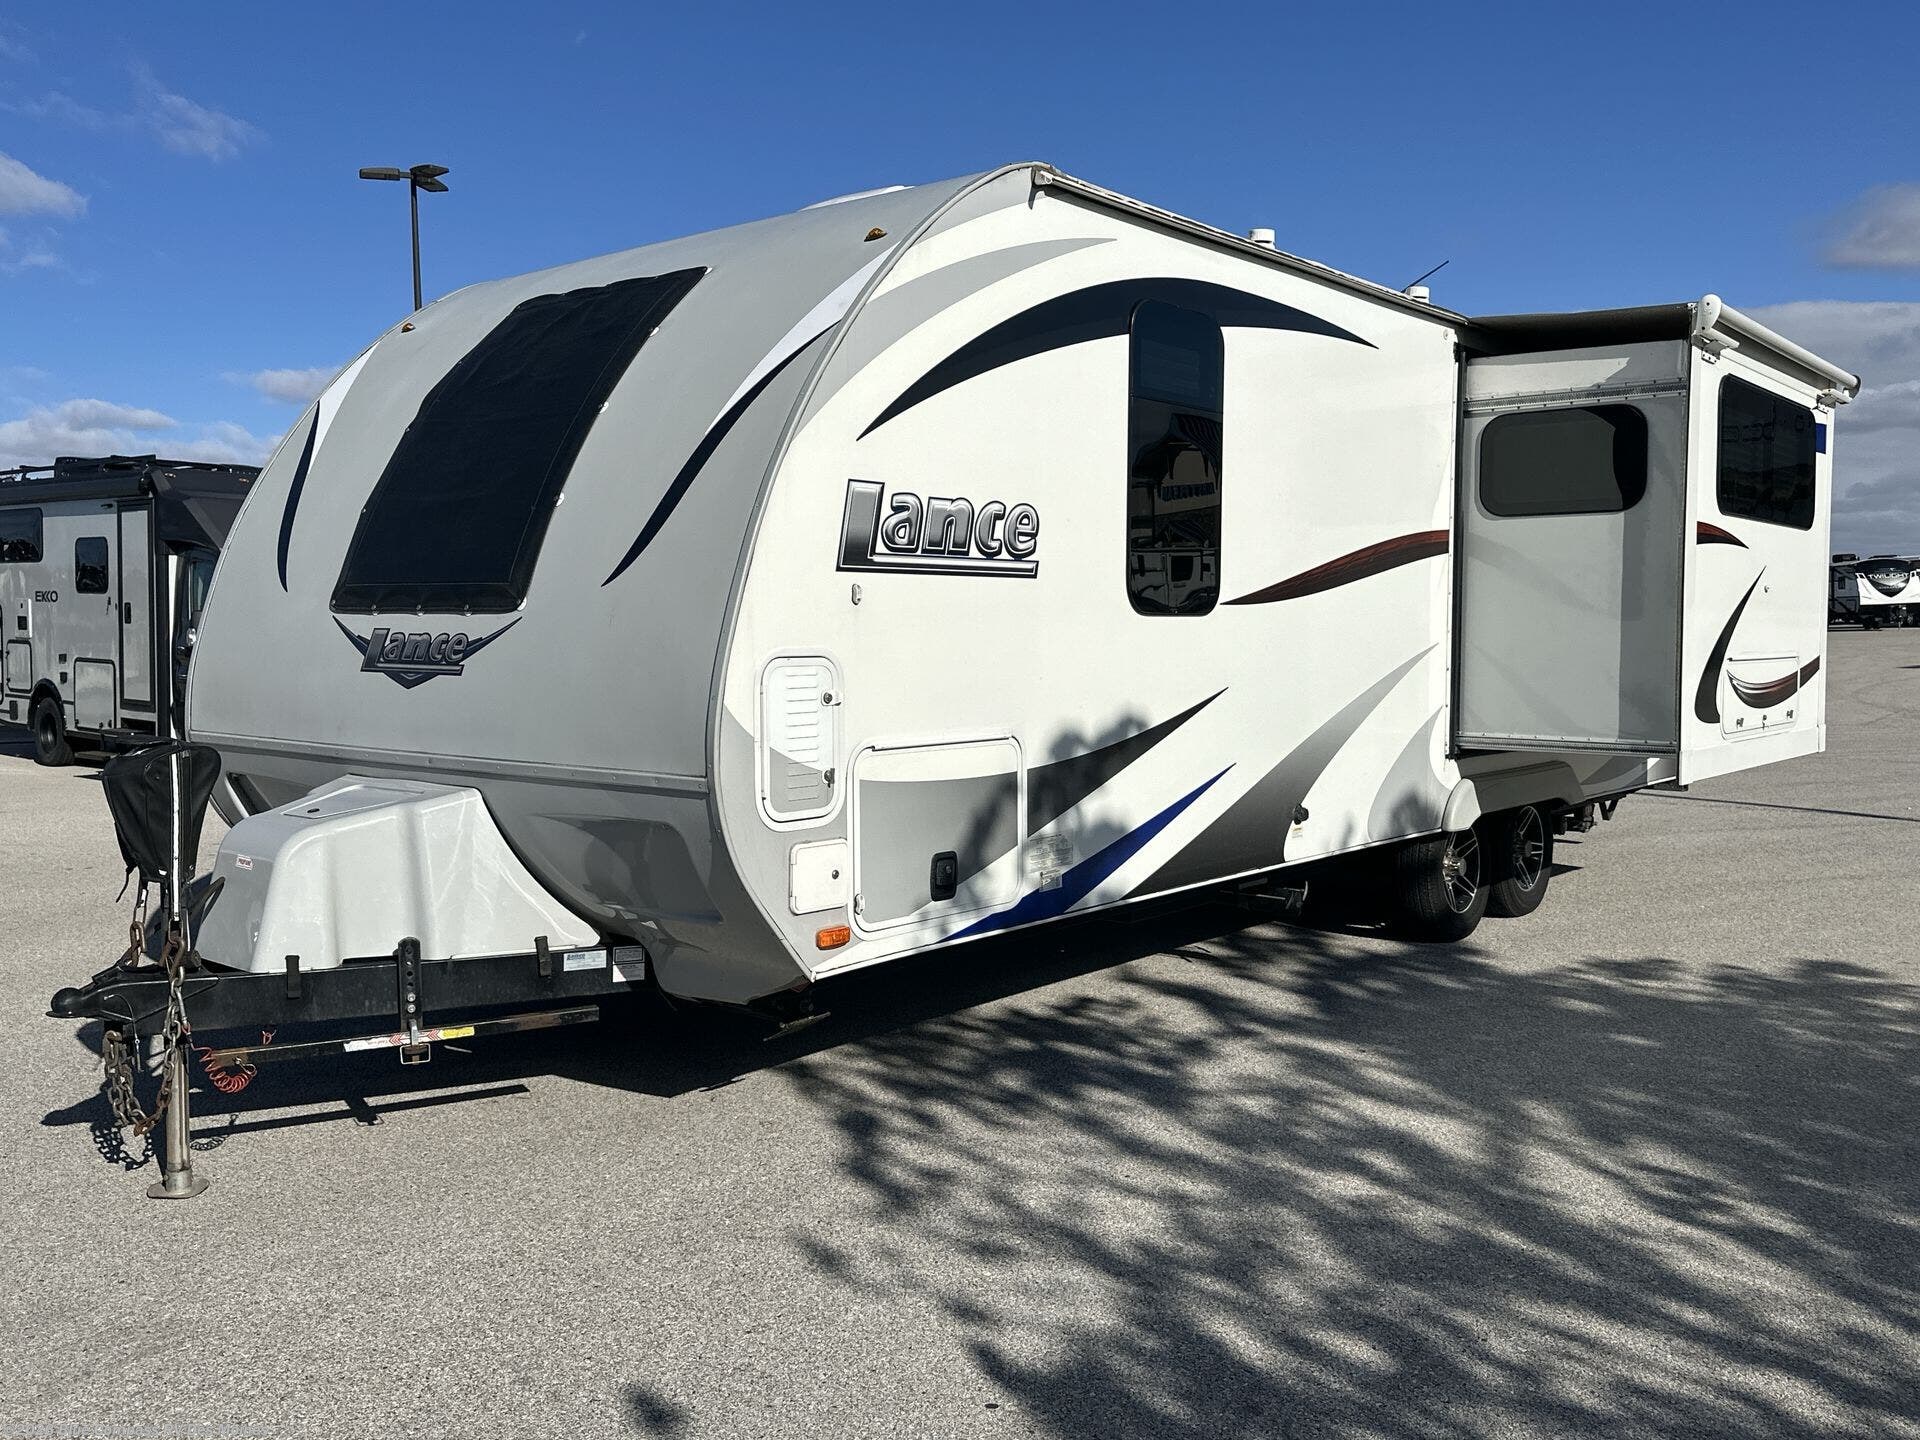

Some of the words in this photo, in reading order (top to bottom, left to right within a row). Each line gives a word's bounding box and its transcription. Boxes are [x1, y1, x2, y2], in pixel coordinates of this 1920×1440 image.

[836, 478, 1039, 579] Lance
[35, 590, 58, 602] EKKO
[360, 627, 468, 676] Lance
